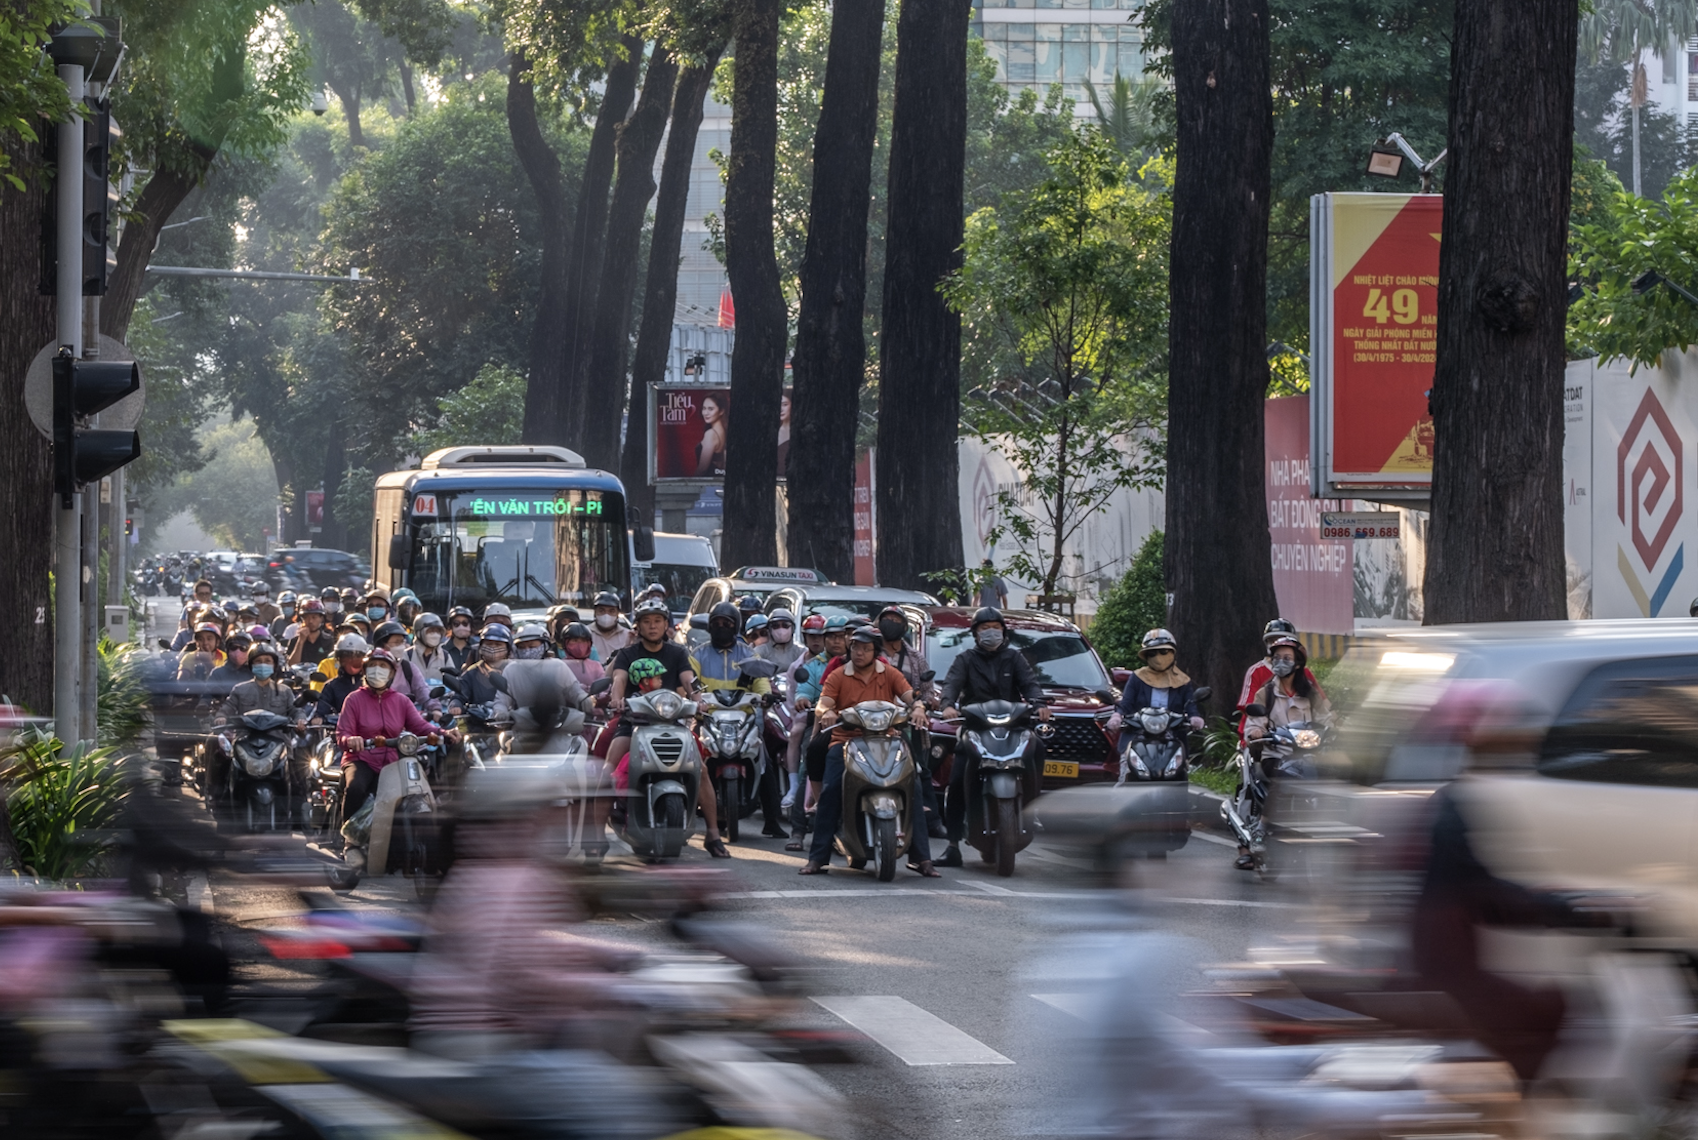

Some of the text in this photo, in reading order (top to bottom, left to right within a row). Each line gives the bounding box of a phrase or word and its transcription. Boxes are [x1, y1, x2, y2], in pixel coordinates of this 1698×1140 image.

[1354, 274, 1376, 286] NHIỆT
[1378, 274, 1394, 287] LIỆT
[1396, 274, 1416, 285] CHÀO
[1363, 289, 1418, 324] 49
[1343, 327, 1364, 337] NGÀY
[1366, 326, 1382, 337] GIẢI
[1384, 327, 1410, 338] PHÓNG
[1354, 338, 1437, 350] THỐNG NHẤT ĐẤT NƯỚ
[1354, 353, 1394, 362] (30/4/1975
[1401, 353, 1436, 363] 30/4/202
[1271, 453, 1310, 486] NHÀ PHÁ
[416, 497, 434, 513] 04
[470, 498, 495, 514] ỄN
[498, 498, 529, 514] VĂN
[1271, 491, 1320, 534] BẤT ĐỘNG
[1271, 539, 1346, 577] CHUYÊN NGHIỆP
[1045, 763, 1073, 775] 09.76
